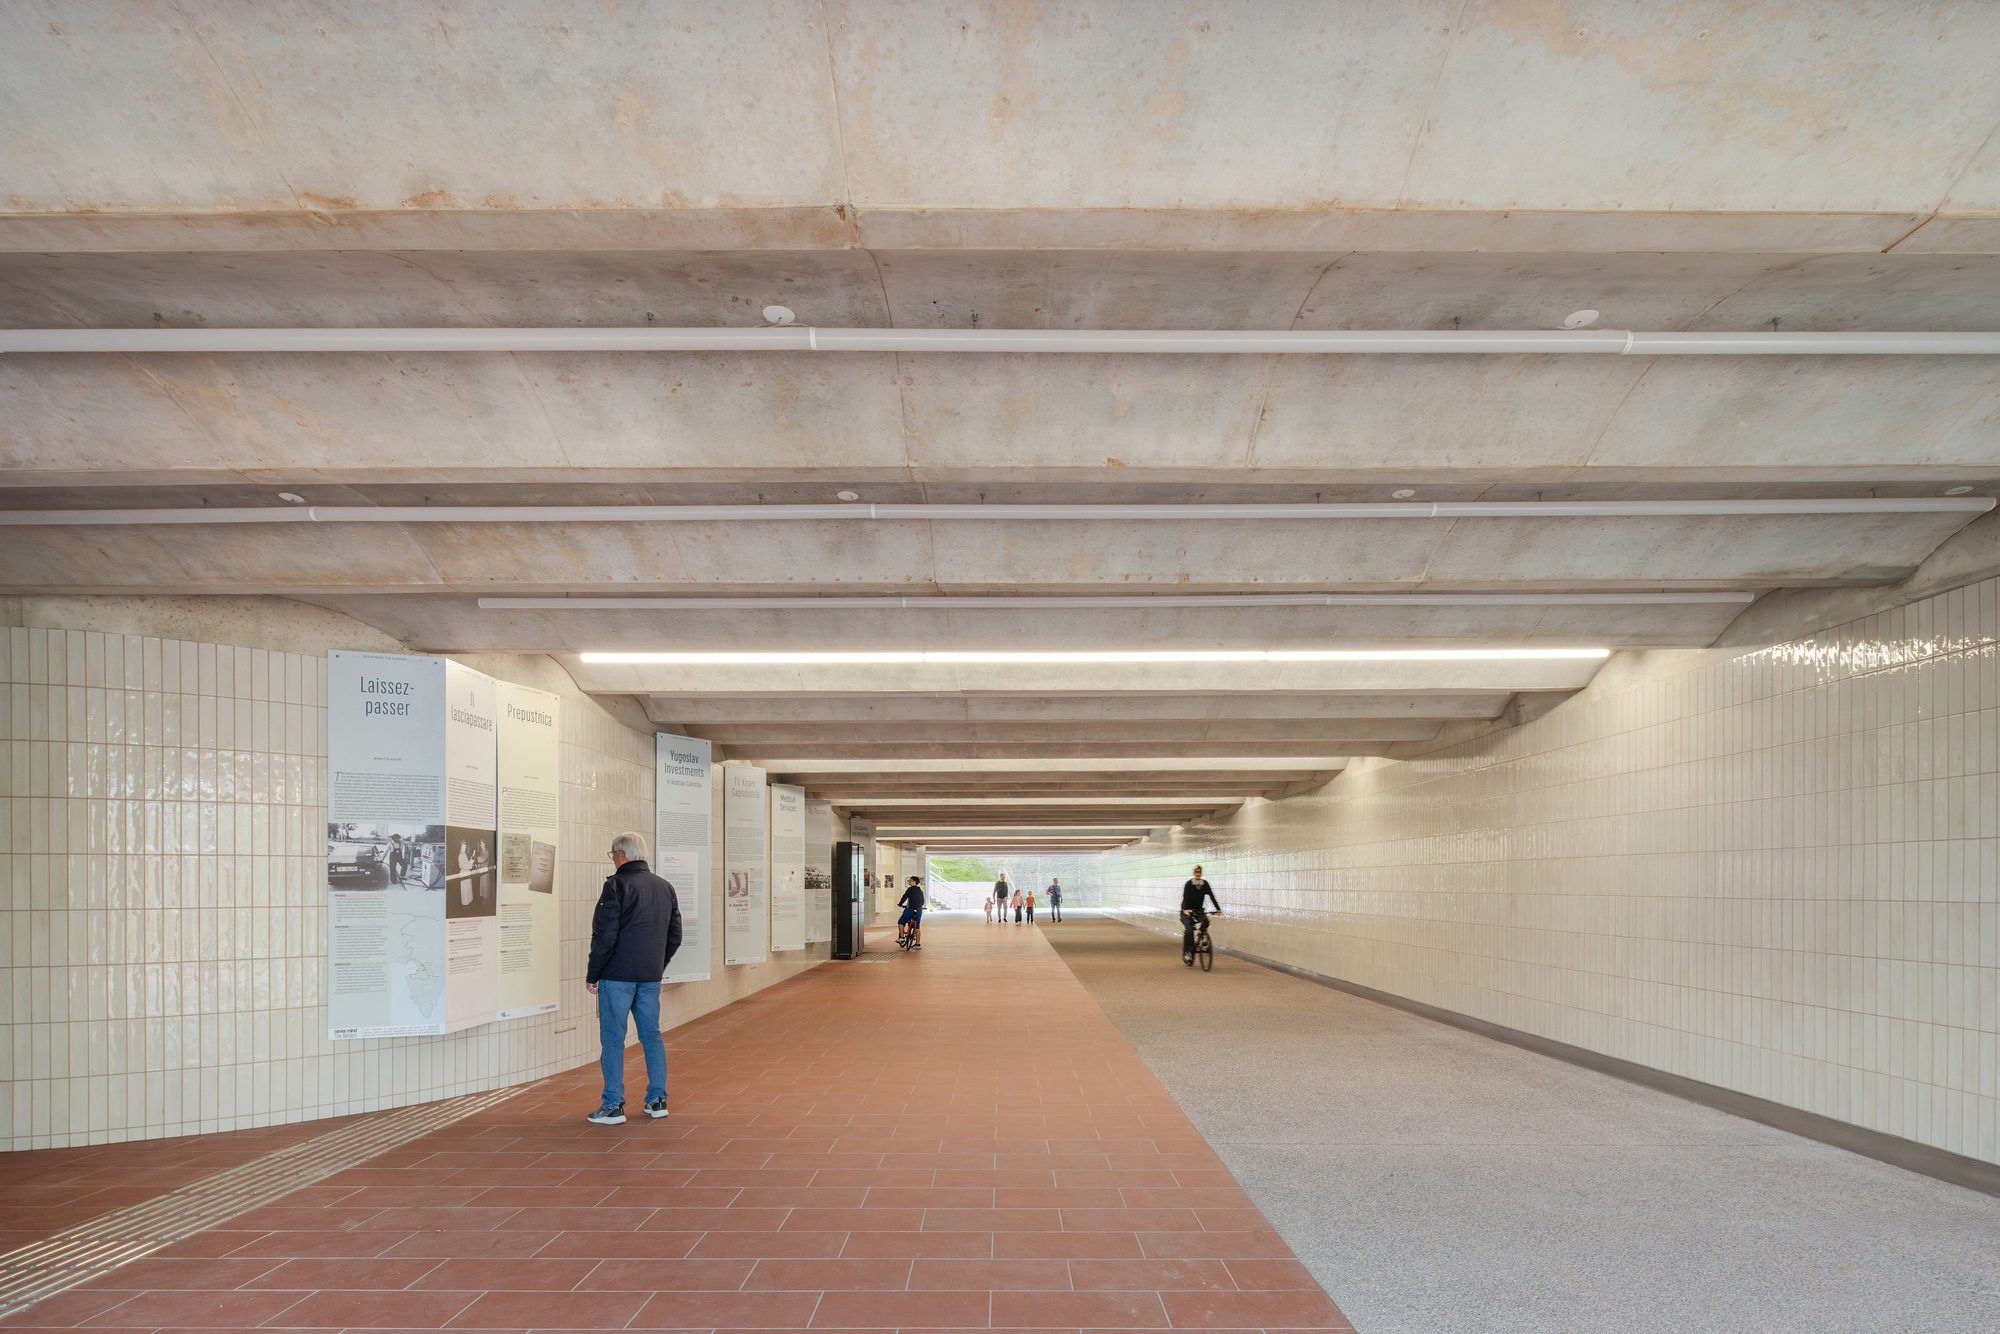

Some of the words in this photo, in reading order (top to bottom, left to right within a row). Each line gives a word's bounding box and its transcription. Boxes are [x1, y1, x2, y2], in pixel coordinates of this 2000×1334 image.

[360, 676, 414, 696] Laissez-
[365, 699, 410, 717] passer
[507, 703, 552, 727] Prepustnica
[451, 704, 493, 732] lasciapassare
[670, 749, 700, 764] Yugoslav
[664, 762, 705, 778] Investments
